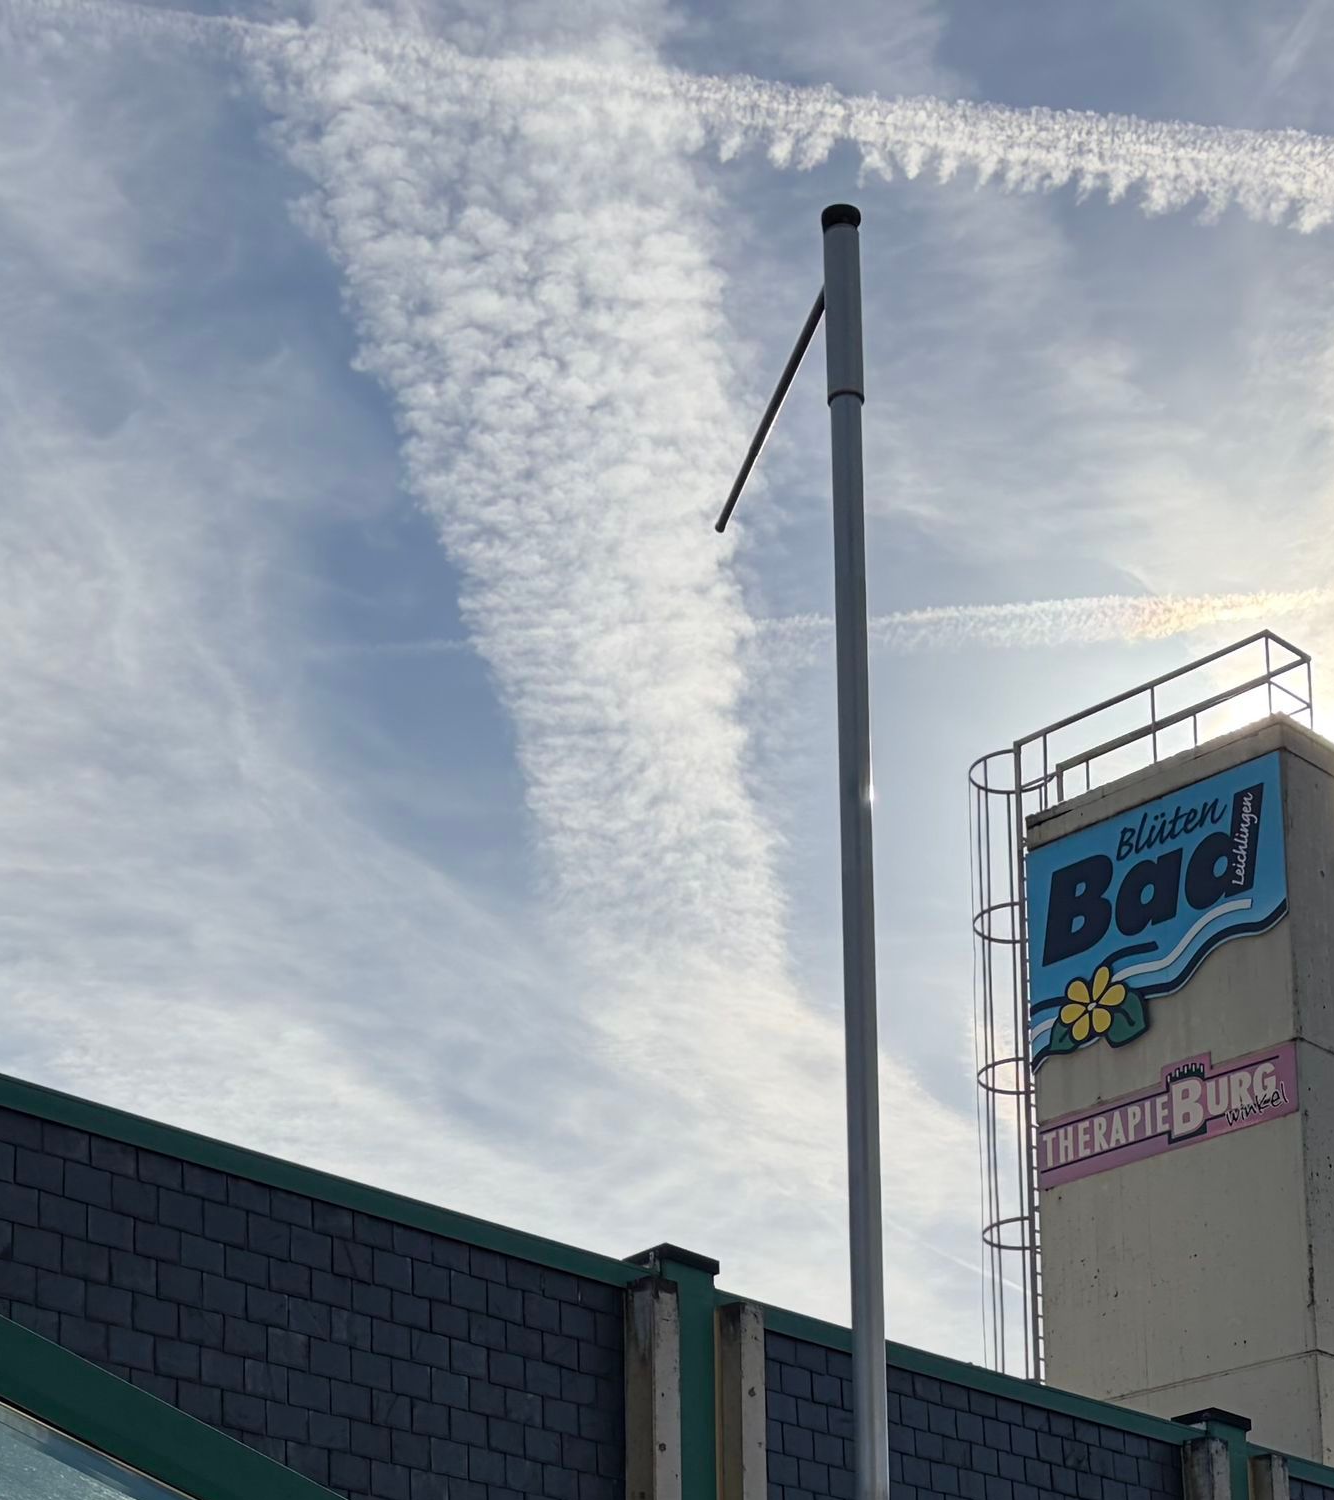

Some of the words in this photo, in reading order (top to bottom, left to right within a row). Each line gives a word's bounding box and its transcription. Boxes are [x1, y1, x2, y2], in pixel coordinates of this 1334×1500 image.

[1116, 796, 1229, 862] Blüten
[1231, 791, 1254, 886] Leichlingen
[1042, 782, 1264, 967] Bad
[1225, 1085, 1289, 1127] winkel
